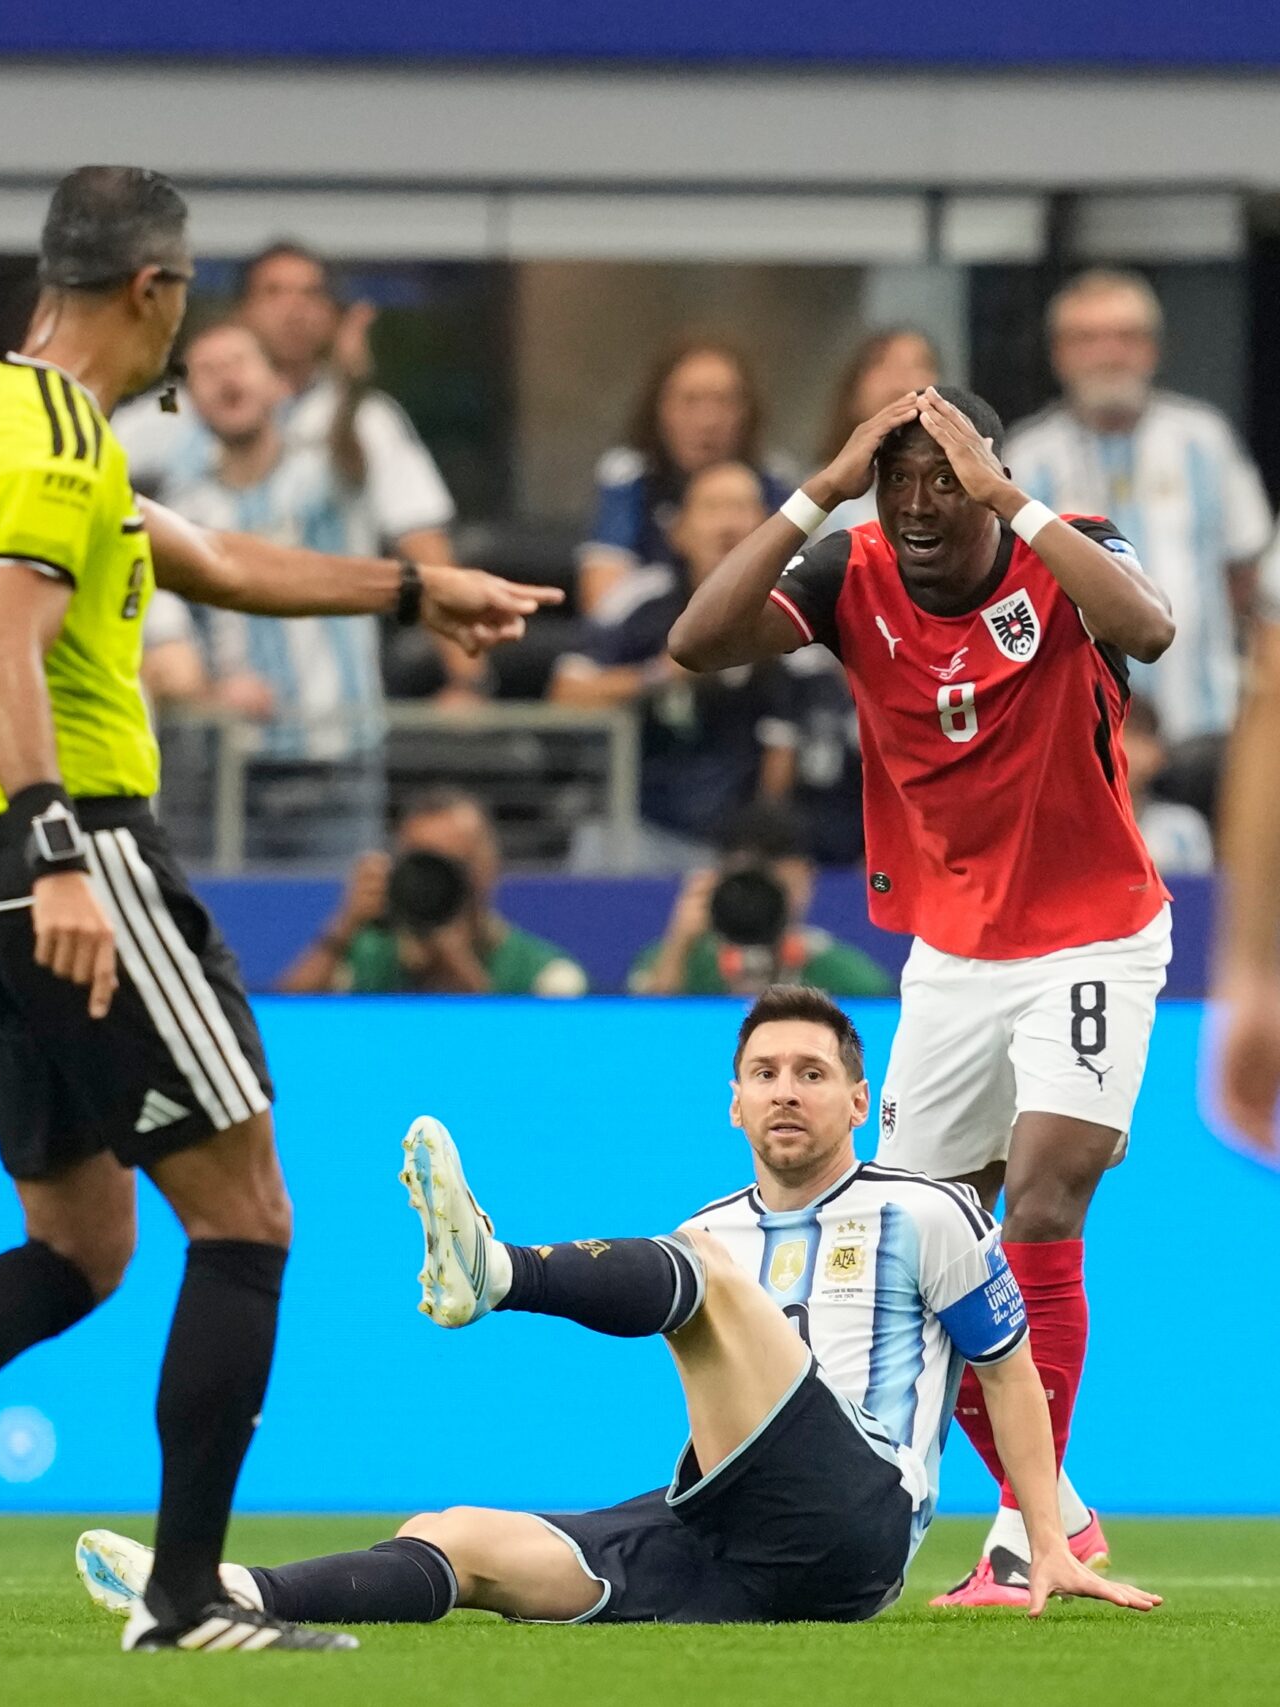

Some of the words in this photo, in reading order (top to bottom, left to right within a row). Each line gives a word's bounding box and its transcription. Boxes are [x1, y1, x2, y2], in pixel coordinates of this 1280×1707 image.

[43, 472, 92, 498] FIFA
[936, 681, 979, 743] 8
[1070, 981, 1107, 1055] 8
[832, 1247, 857, 1270] AFA
[987, 1280, 1022, 1311] UNITE
